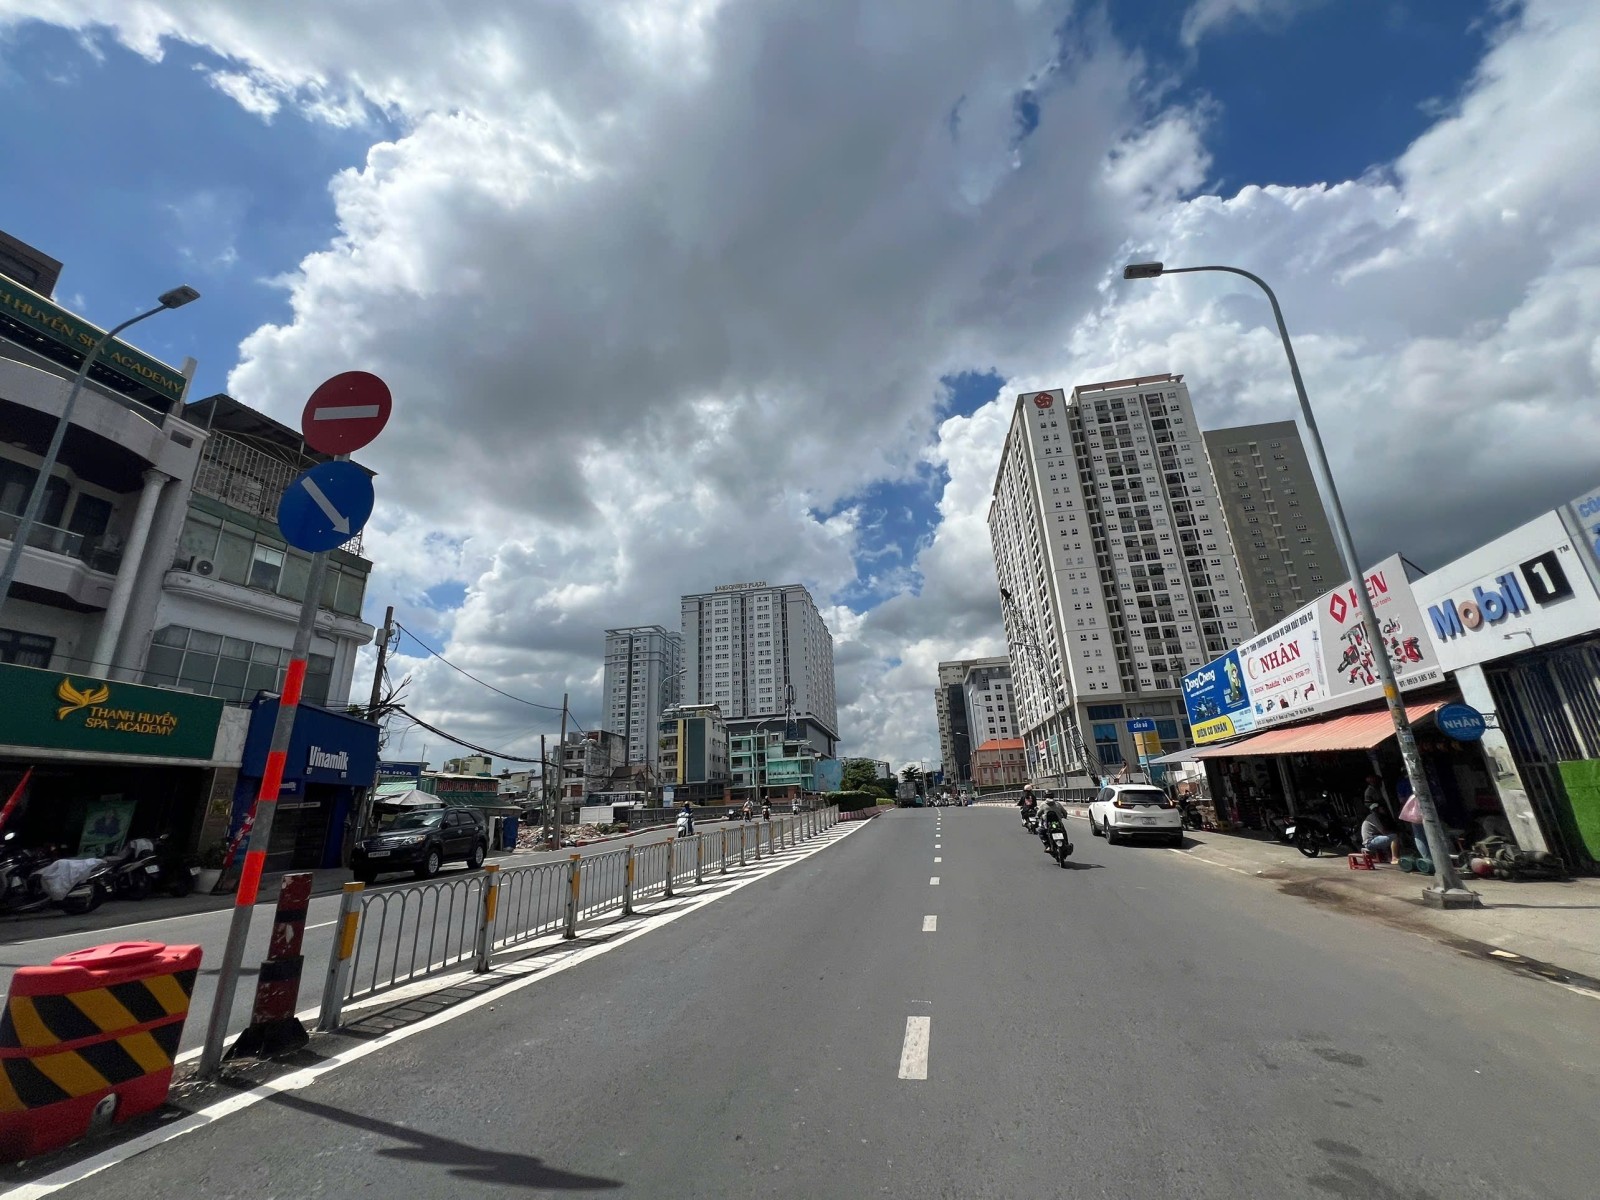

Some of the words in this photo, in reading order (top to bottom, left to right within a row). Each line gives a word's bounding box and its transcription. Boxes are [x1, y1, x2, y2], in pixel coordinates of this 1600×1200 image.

[79, 333, 104, 354] SP
[111, 351, 183, 393] ACADEMY
[1427, 571, 1529, 640] Mobil
[1531, 562, 1556, 594] 1
[1260, 640, 1301, 674] NHÂN
[90, 706, 135, 721] THANH
[1442, 716, 1480, 729] NHÂN
[85, 717, 109, 729] SPA
[115, 721, 174, 736] ACADEMY
[309, 746, 349, 770] Vinamilk
